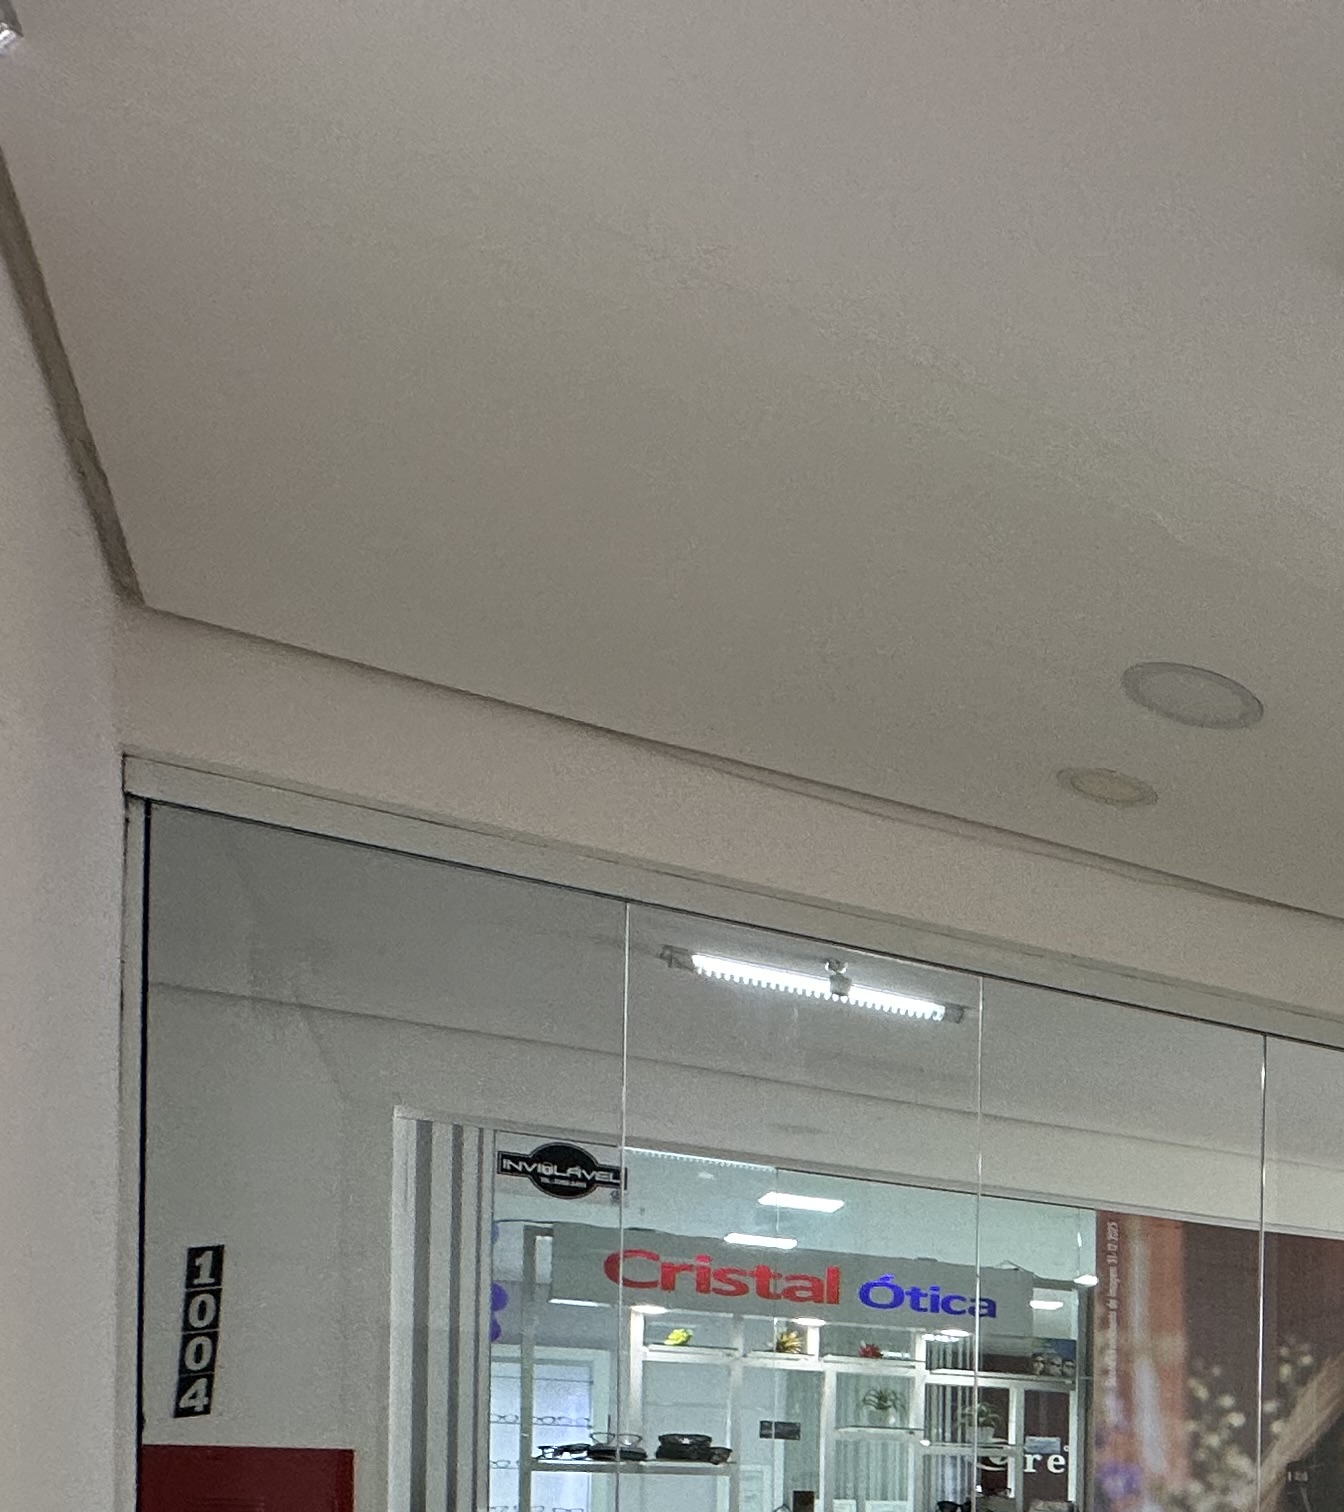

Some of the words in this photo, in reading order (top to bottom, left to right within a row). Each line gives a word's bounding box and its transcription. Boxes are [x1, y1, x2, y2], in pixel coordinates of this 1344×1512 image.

[179, 1250, 217, 1413] 1004
[603, 1249, 840, 1305] Cristal
[858, 1273, 997, 1318] Ótica
